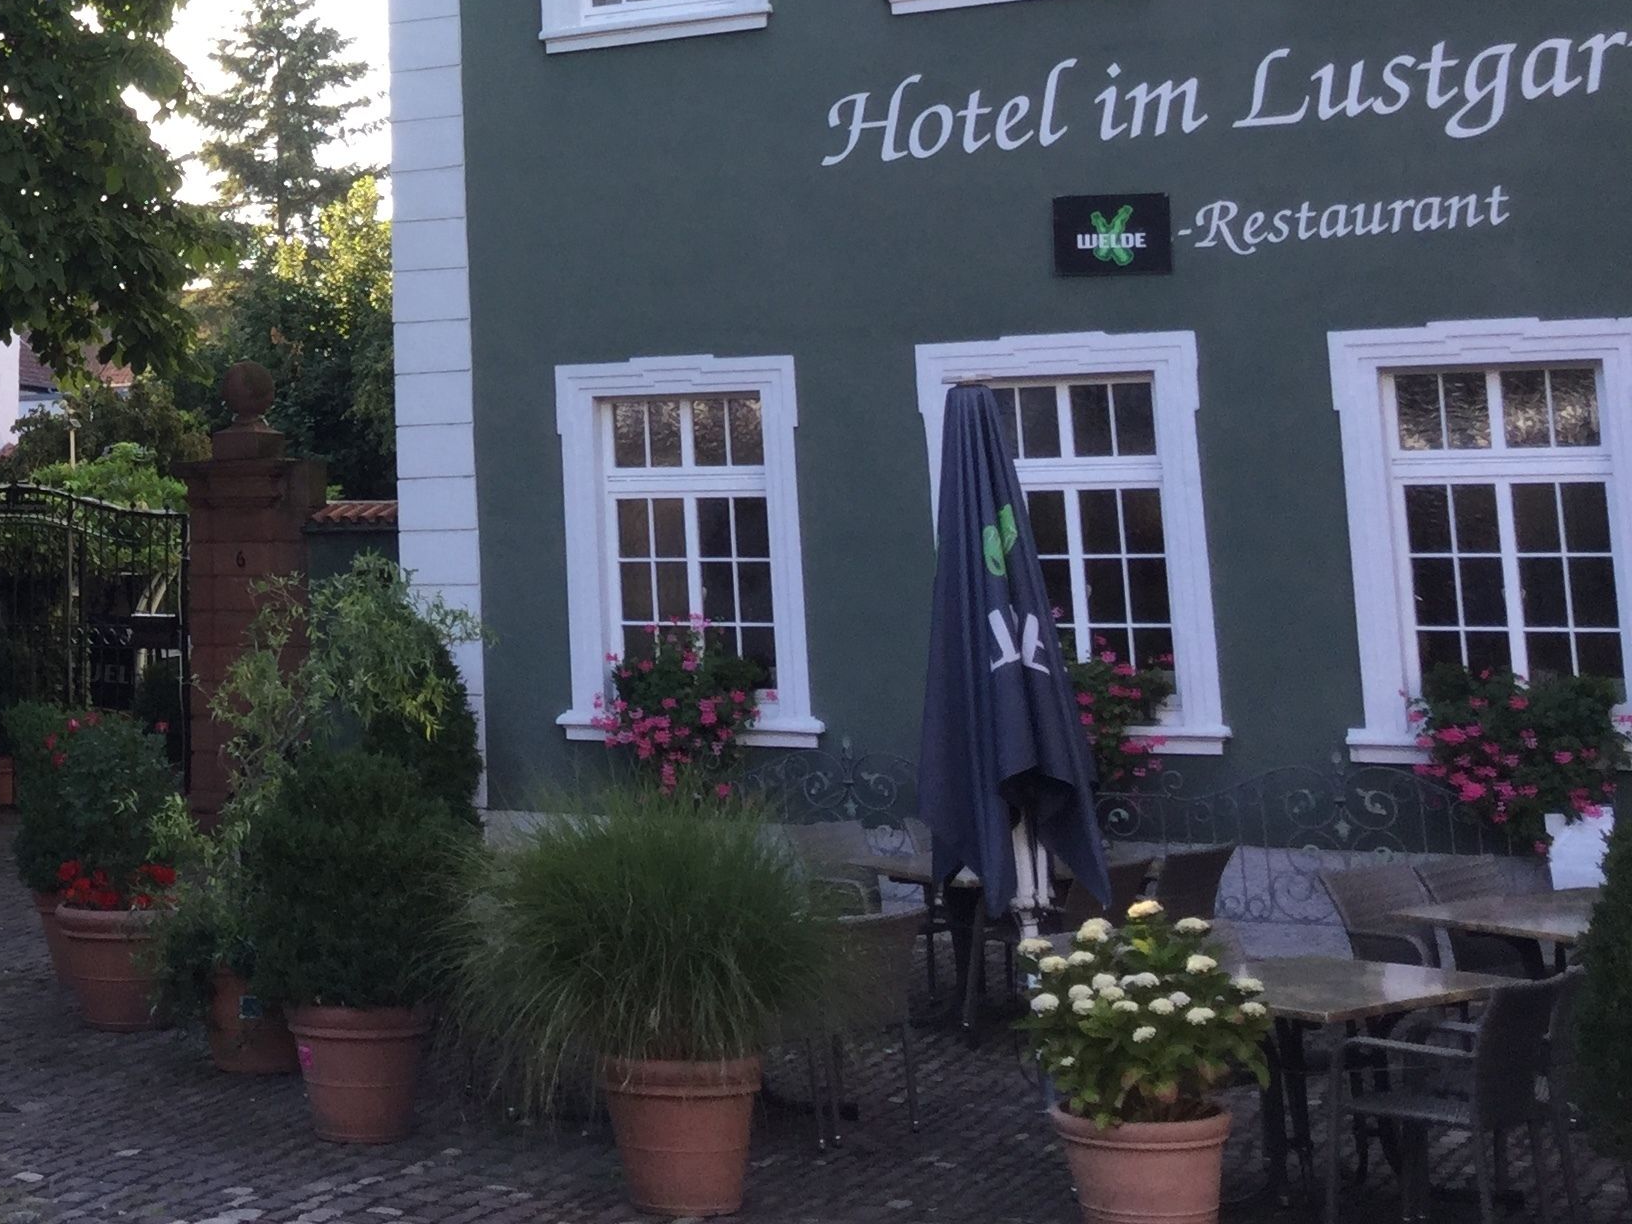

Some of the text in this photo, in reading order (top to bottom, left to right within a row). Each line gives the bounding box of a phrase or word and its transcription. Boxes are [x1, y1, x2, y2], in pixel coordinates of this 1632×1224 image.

[820, 31, 1632, 167] Hotel im Lustgar
[1076, 232, 1148, 250] WELDE
[235, 549, 246, 568] 6
